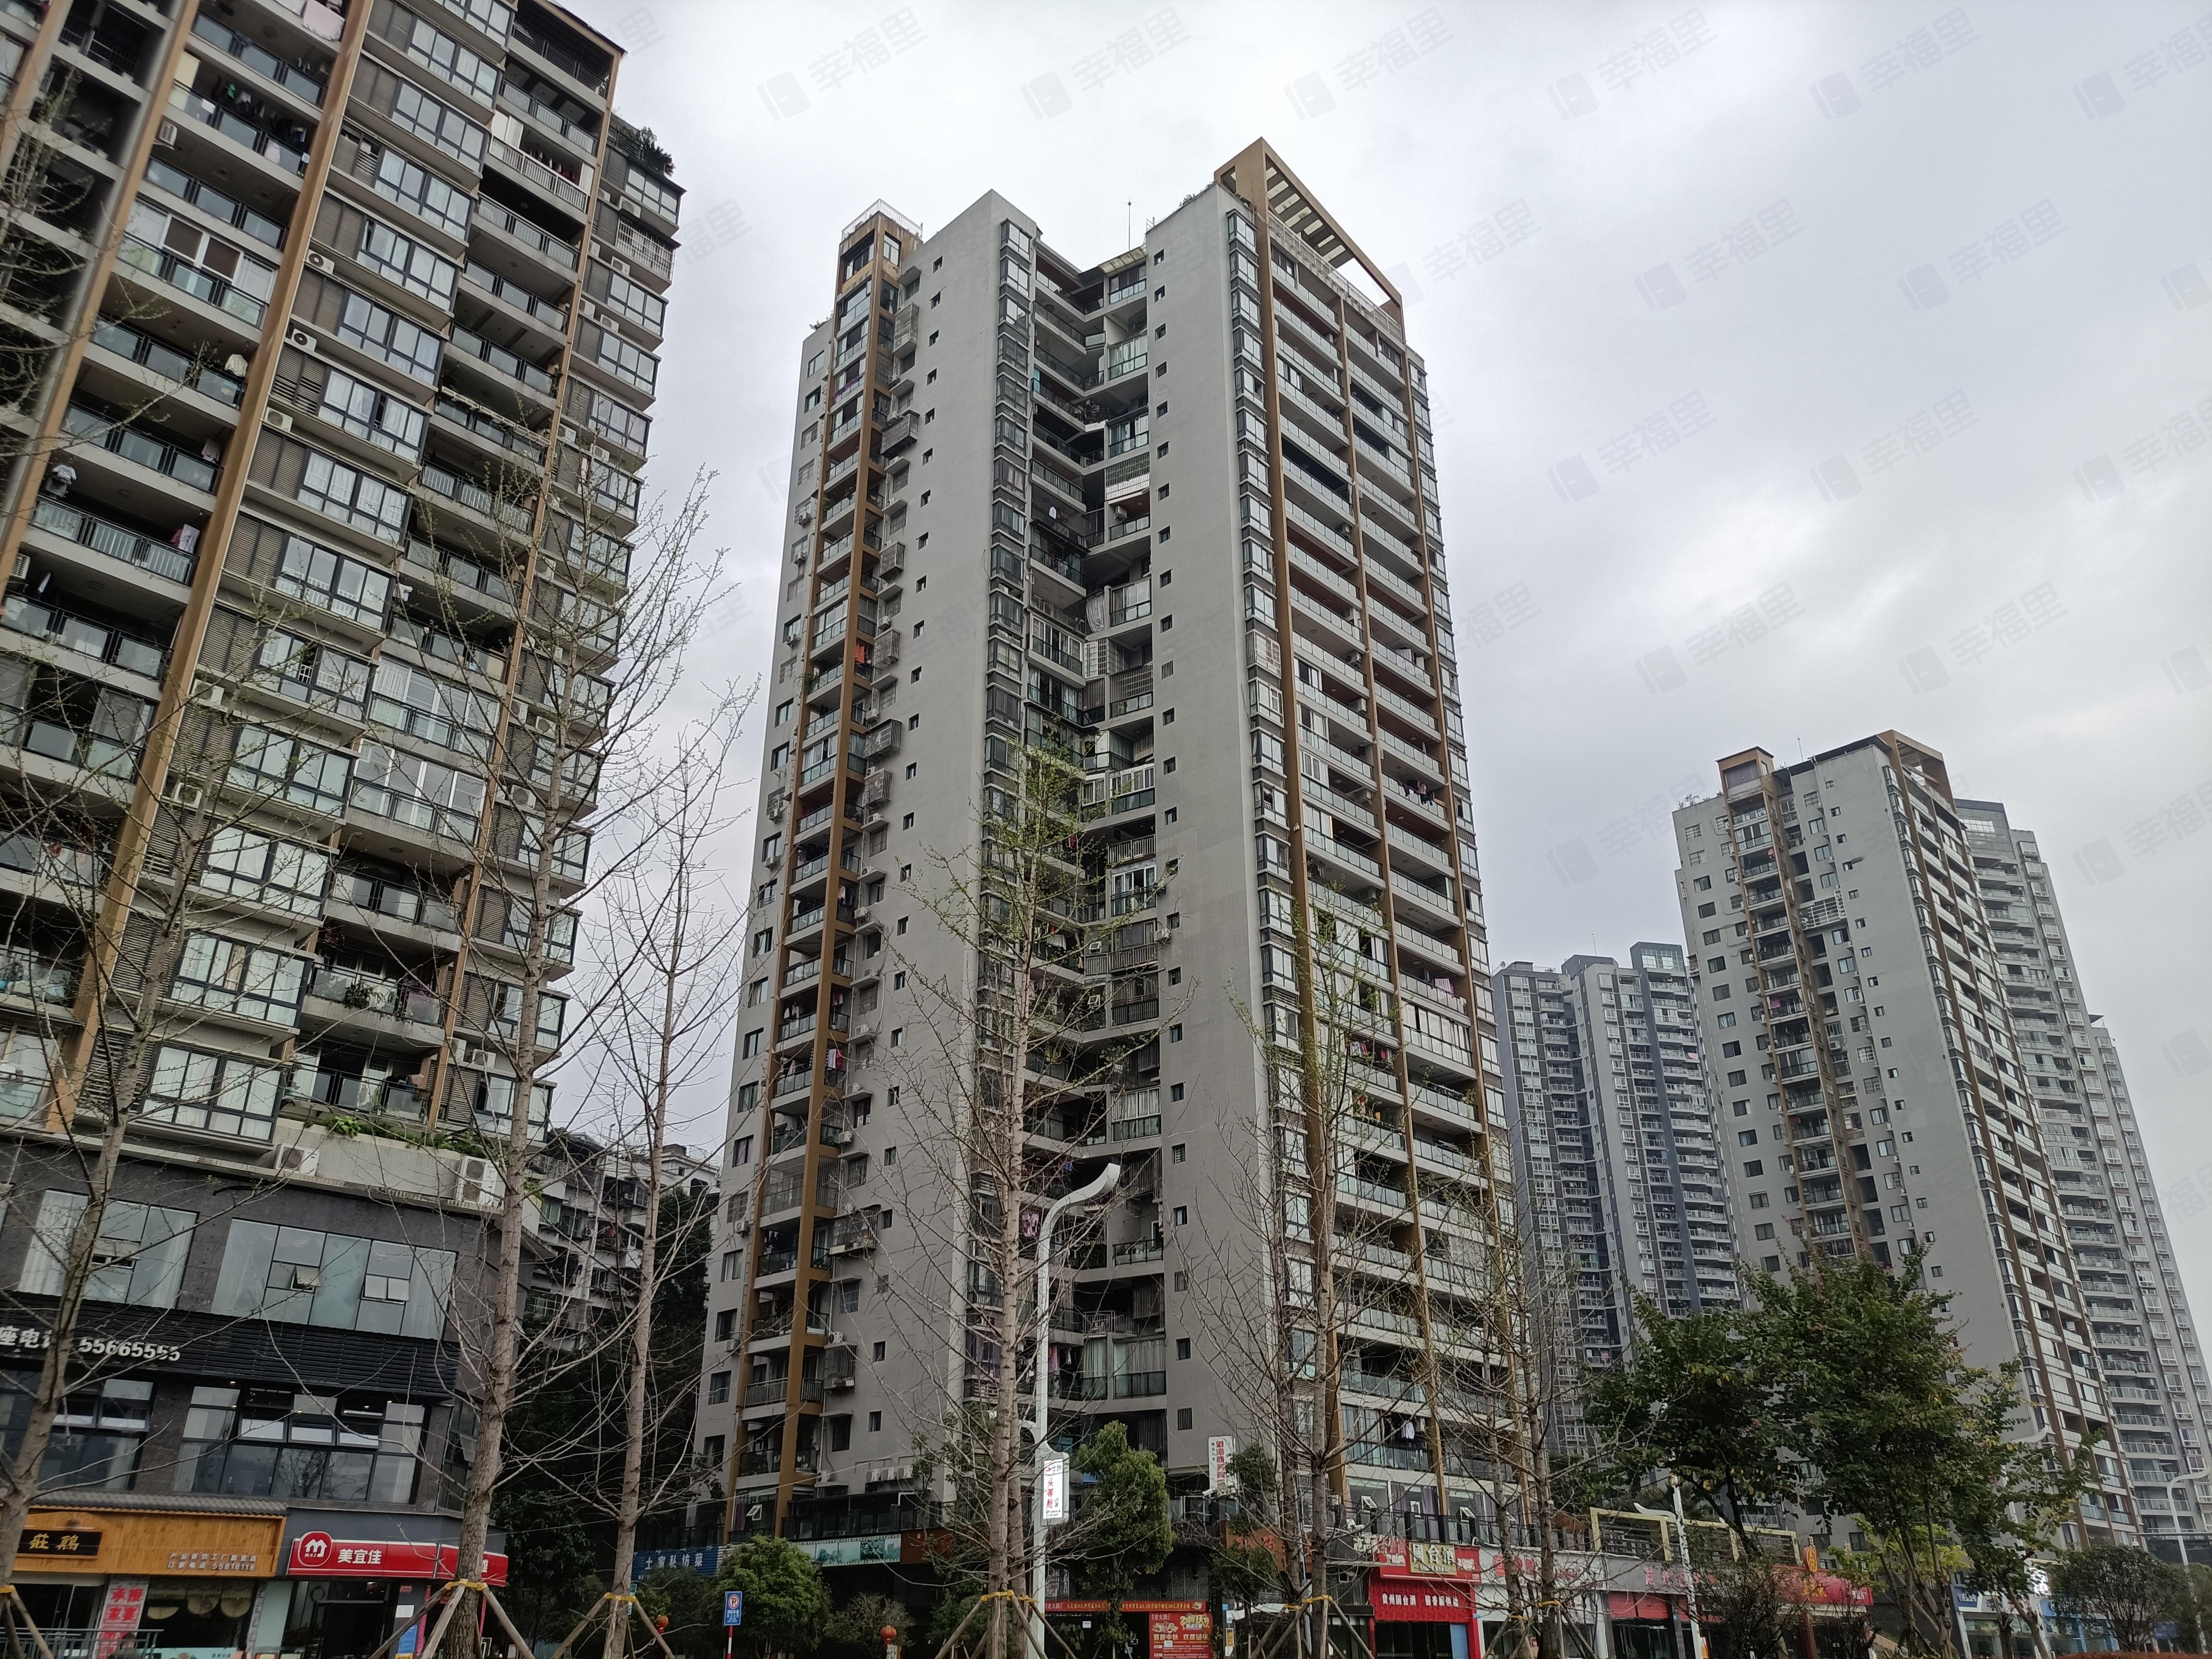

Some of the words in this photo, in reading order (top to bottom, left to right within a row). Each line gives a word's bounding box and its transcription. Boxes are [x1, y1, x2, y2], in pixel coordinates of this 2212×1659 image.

[78, 1337, 180, 1361] 55665555
[338, 1548, 382, 1564] 美宜佳
